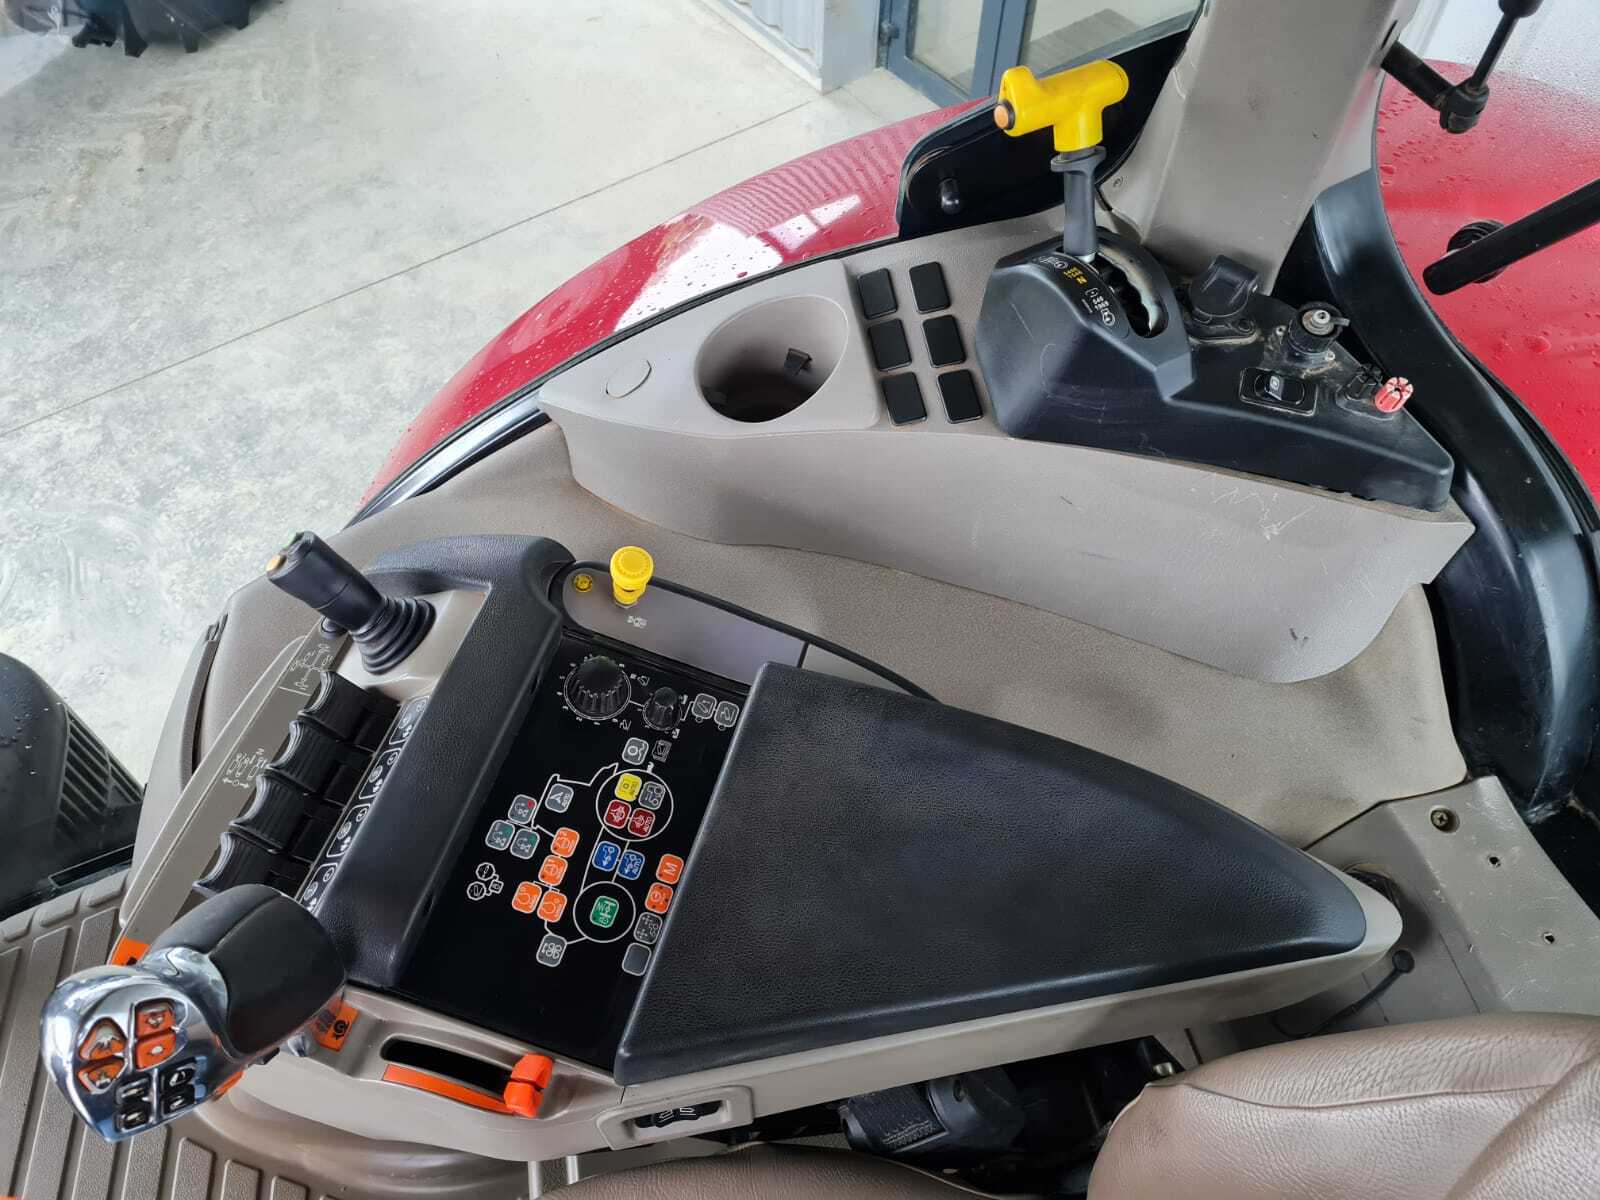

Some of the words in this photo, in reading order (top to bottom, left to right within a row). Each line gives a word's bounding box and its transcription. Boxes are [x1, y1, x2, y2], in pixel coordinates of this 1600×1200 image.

[643, 815, 653, 833] AUTO
[631, 857, 642, 875] AUTO
[663, 862, 677, 876] M
